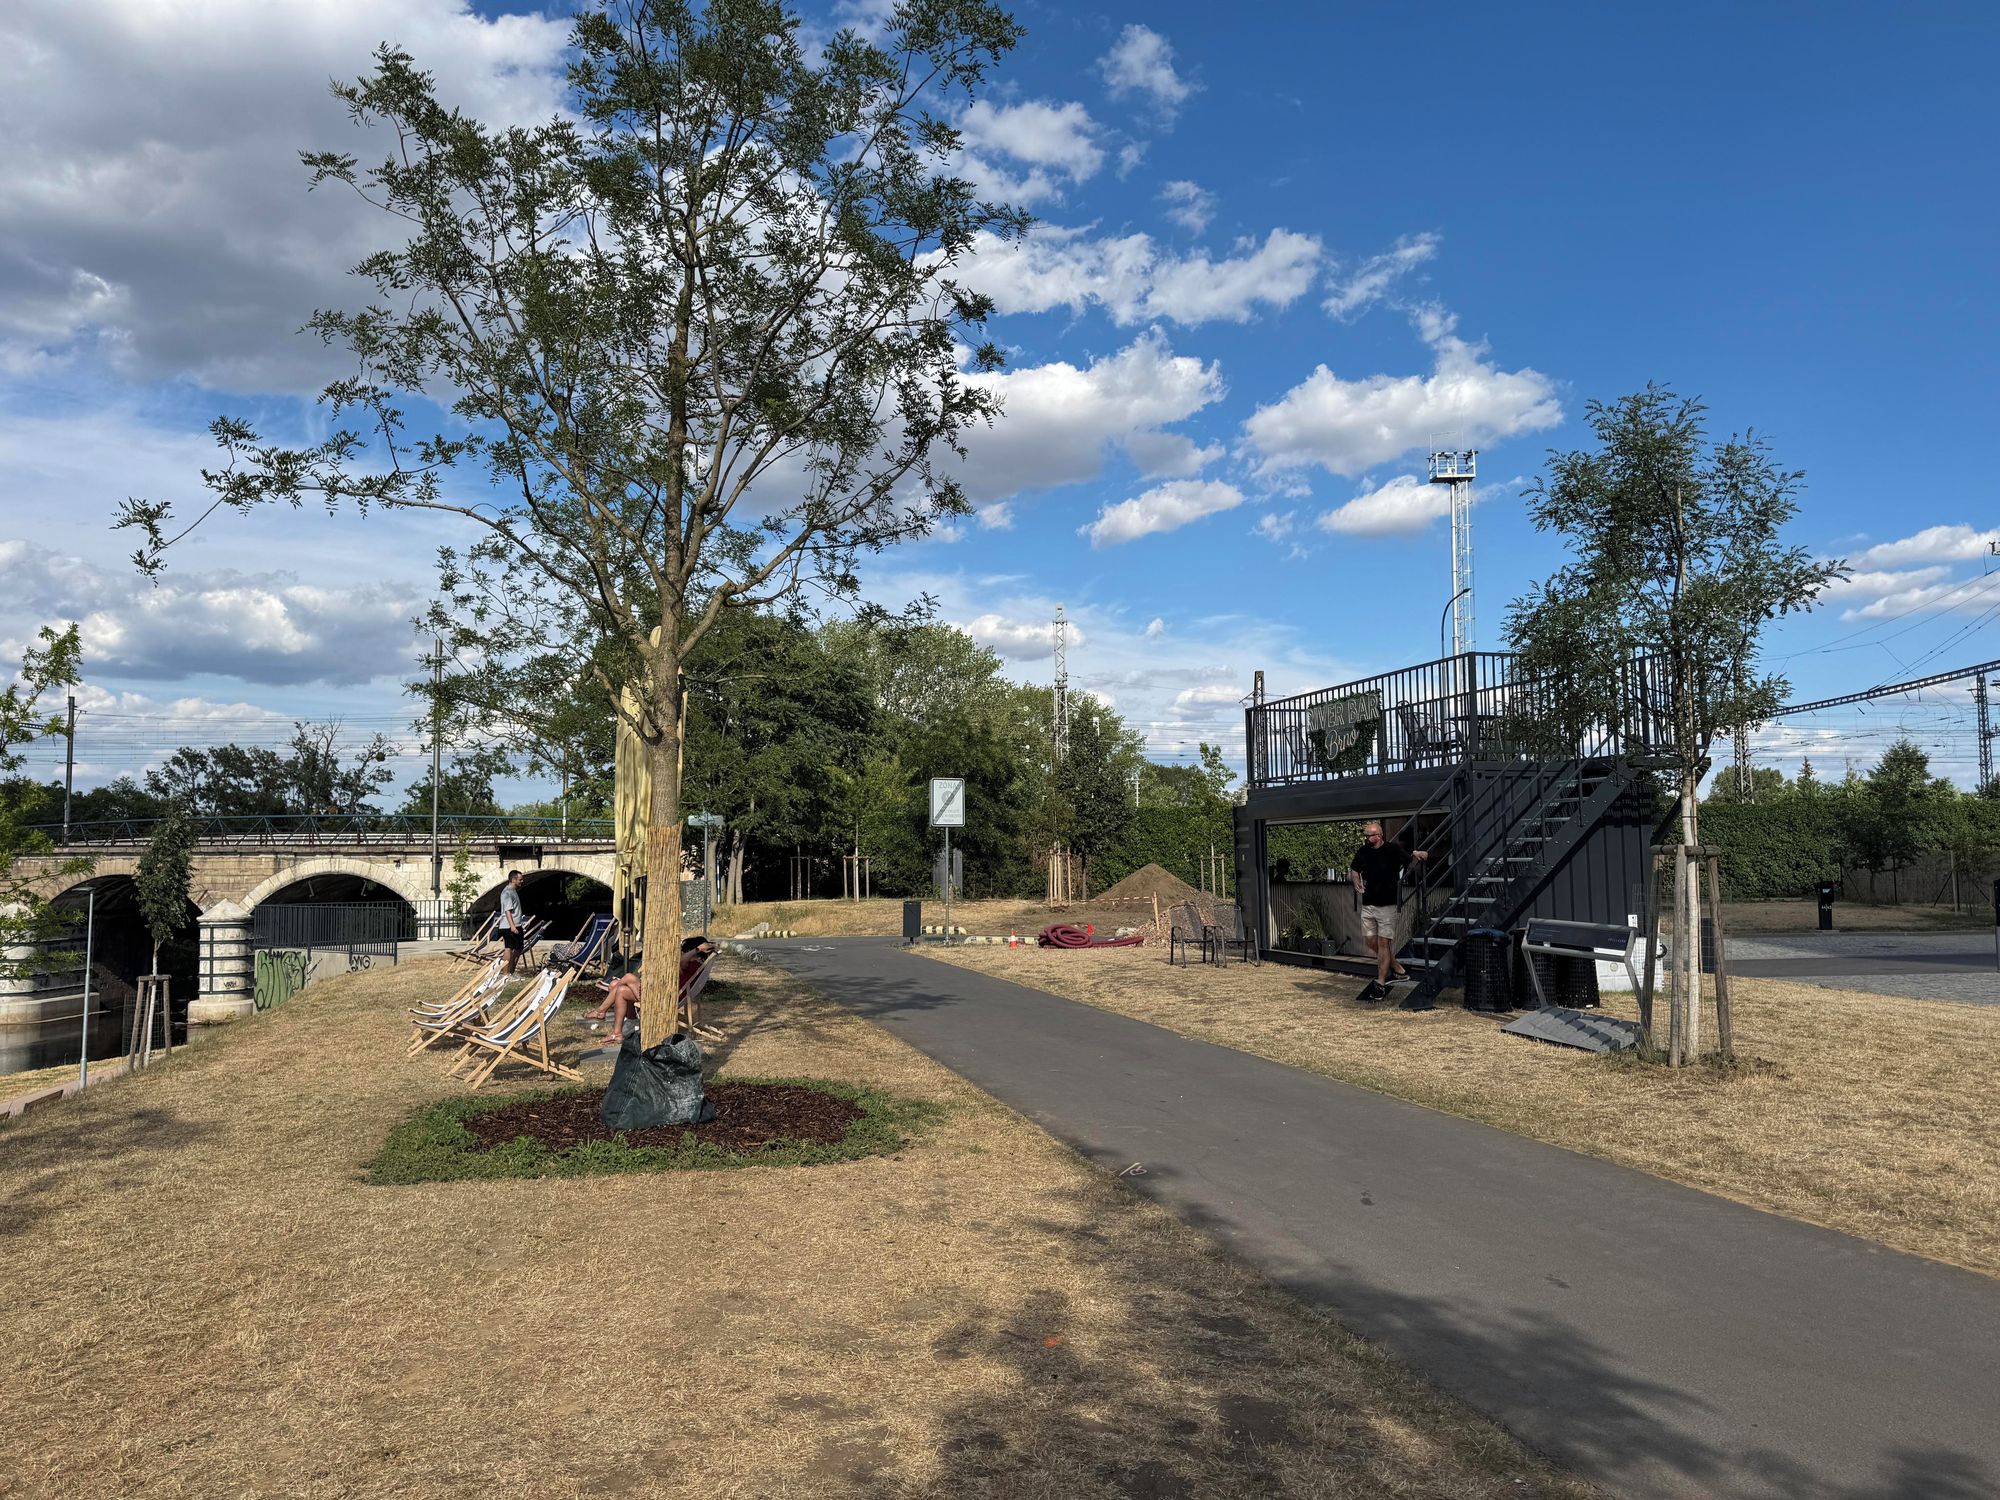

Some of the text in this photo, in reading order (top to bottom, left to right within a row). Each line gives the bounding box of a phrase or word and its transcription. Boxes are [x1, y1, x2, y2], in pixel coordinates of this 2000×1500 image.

[1307, 693, 1380, 731] RIVER BAR
[1325, 729, 1360, 760] Brno
